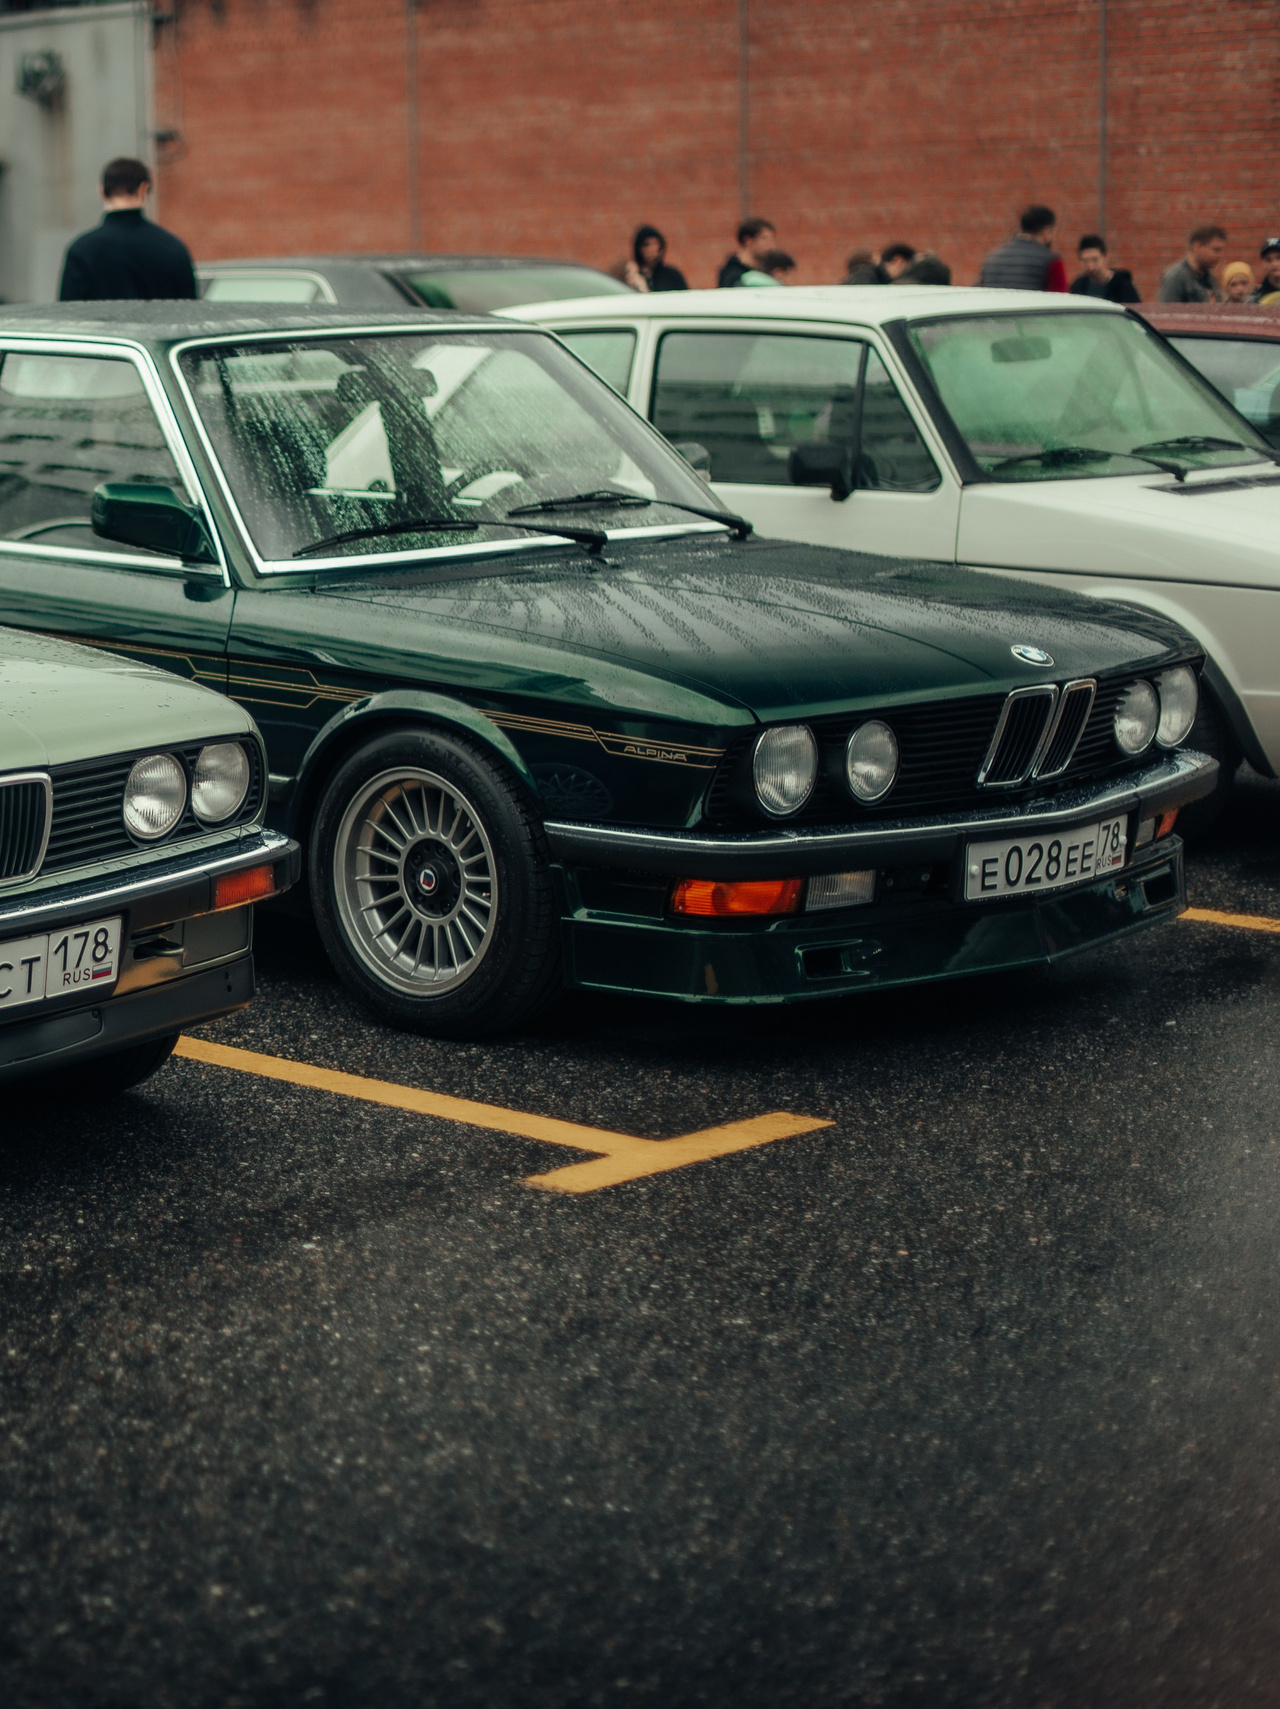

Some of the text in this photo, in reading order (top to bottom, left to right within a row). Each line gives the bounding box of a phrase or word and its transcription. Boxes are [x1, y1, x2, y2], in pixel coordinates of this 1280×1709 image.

[623, 745, 688, 762] ALPINA
[981, 821, 1121, 892] E028EE 78
[1096, 856, 1112, 870] RUS
[52, 927, 110, 972] 178
[62, 969, 91, 986] RUS
